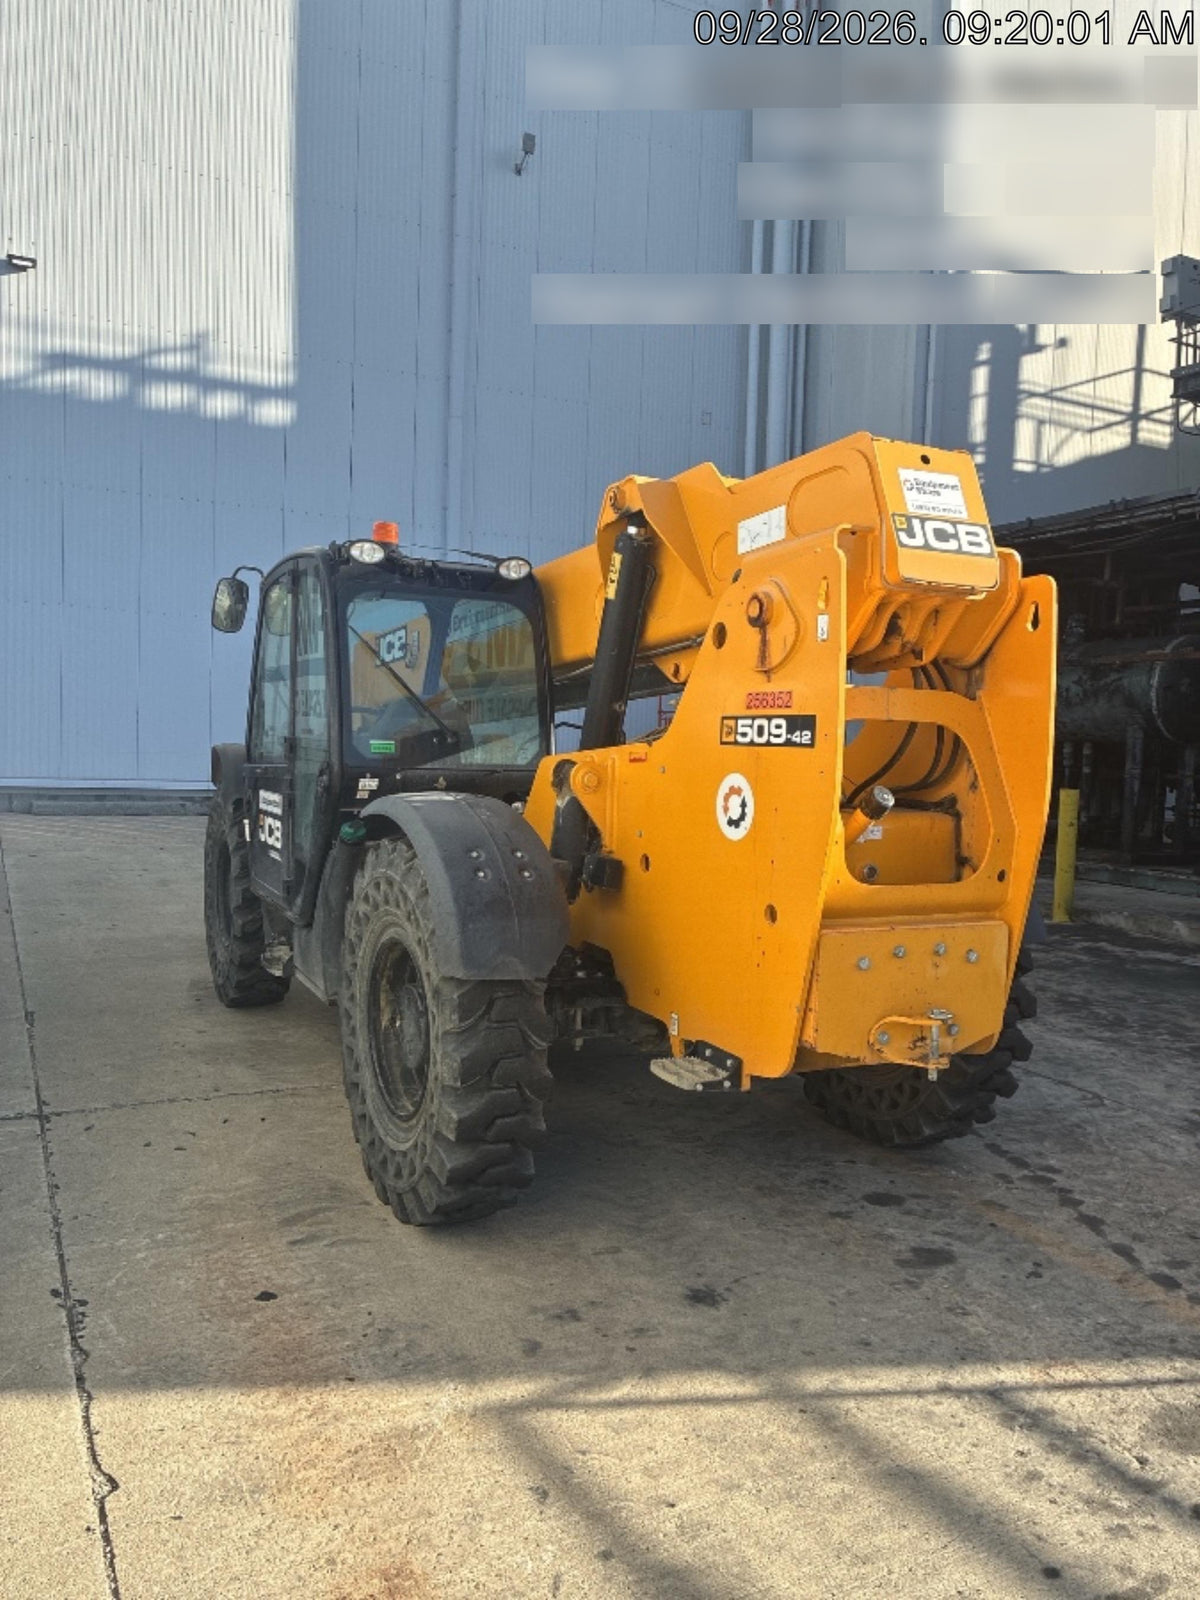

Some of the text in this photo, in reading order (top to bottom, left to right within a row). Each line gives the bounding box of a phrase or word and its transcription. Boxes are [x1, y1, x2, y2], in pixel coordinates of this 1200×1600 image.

[897, 518, 992, 554] JCB
[745, 690, 793, 710] 256352
[735, 717, 812, 744] 509-42
[259, 814, 282, 850] JCB
